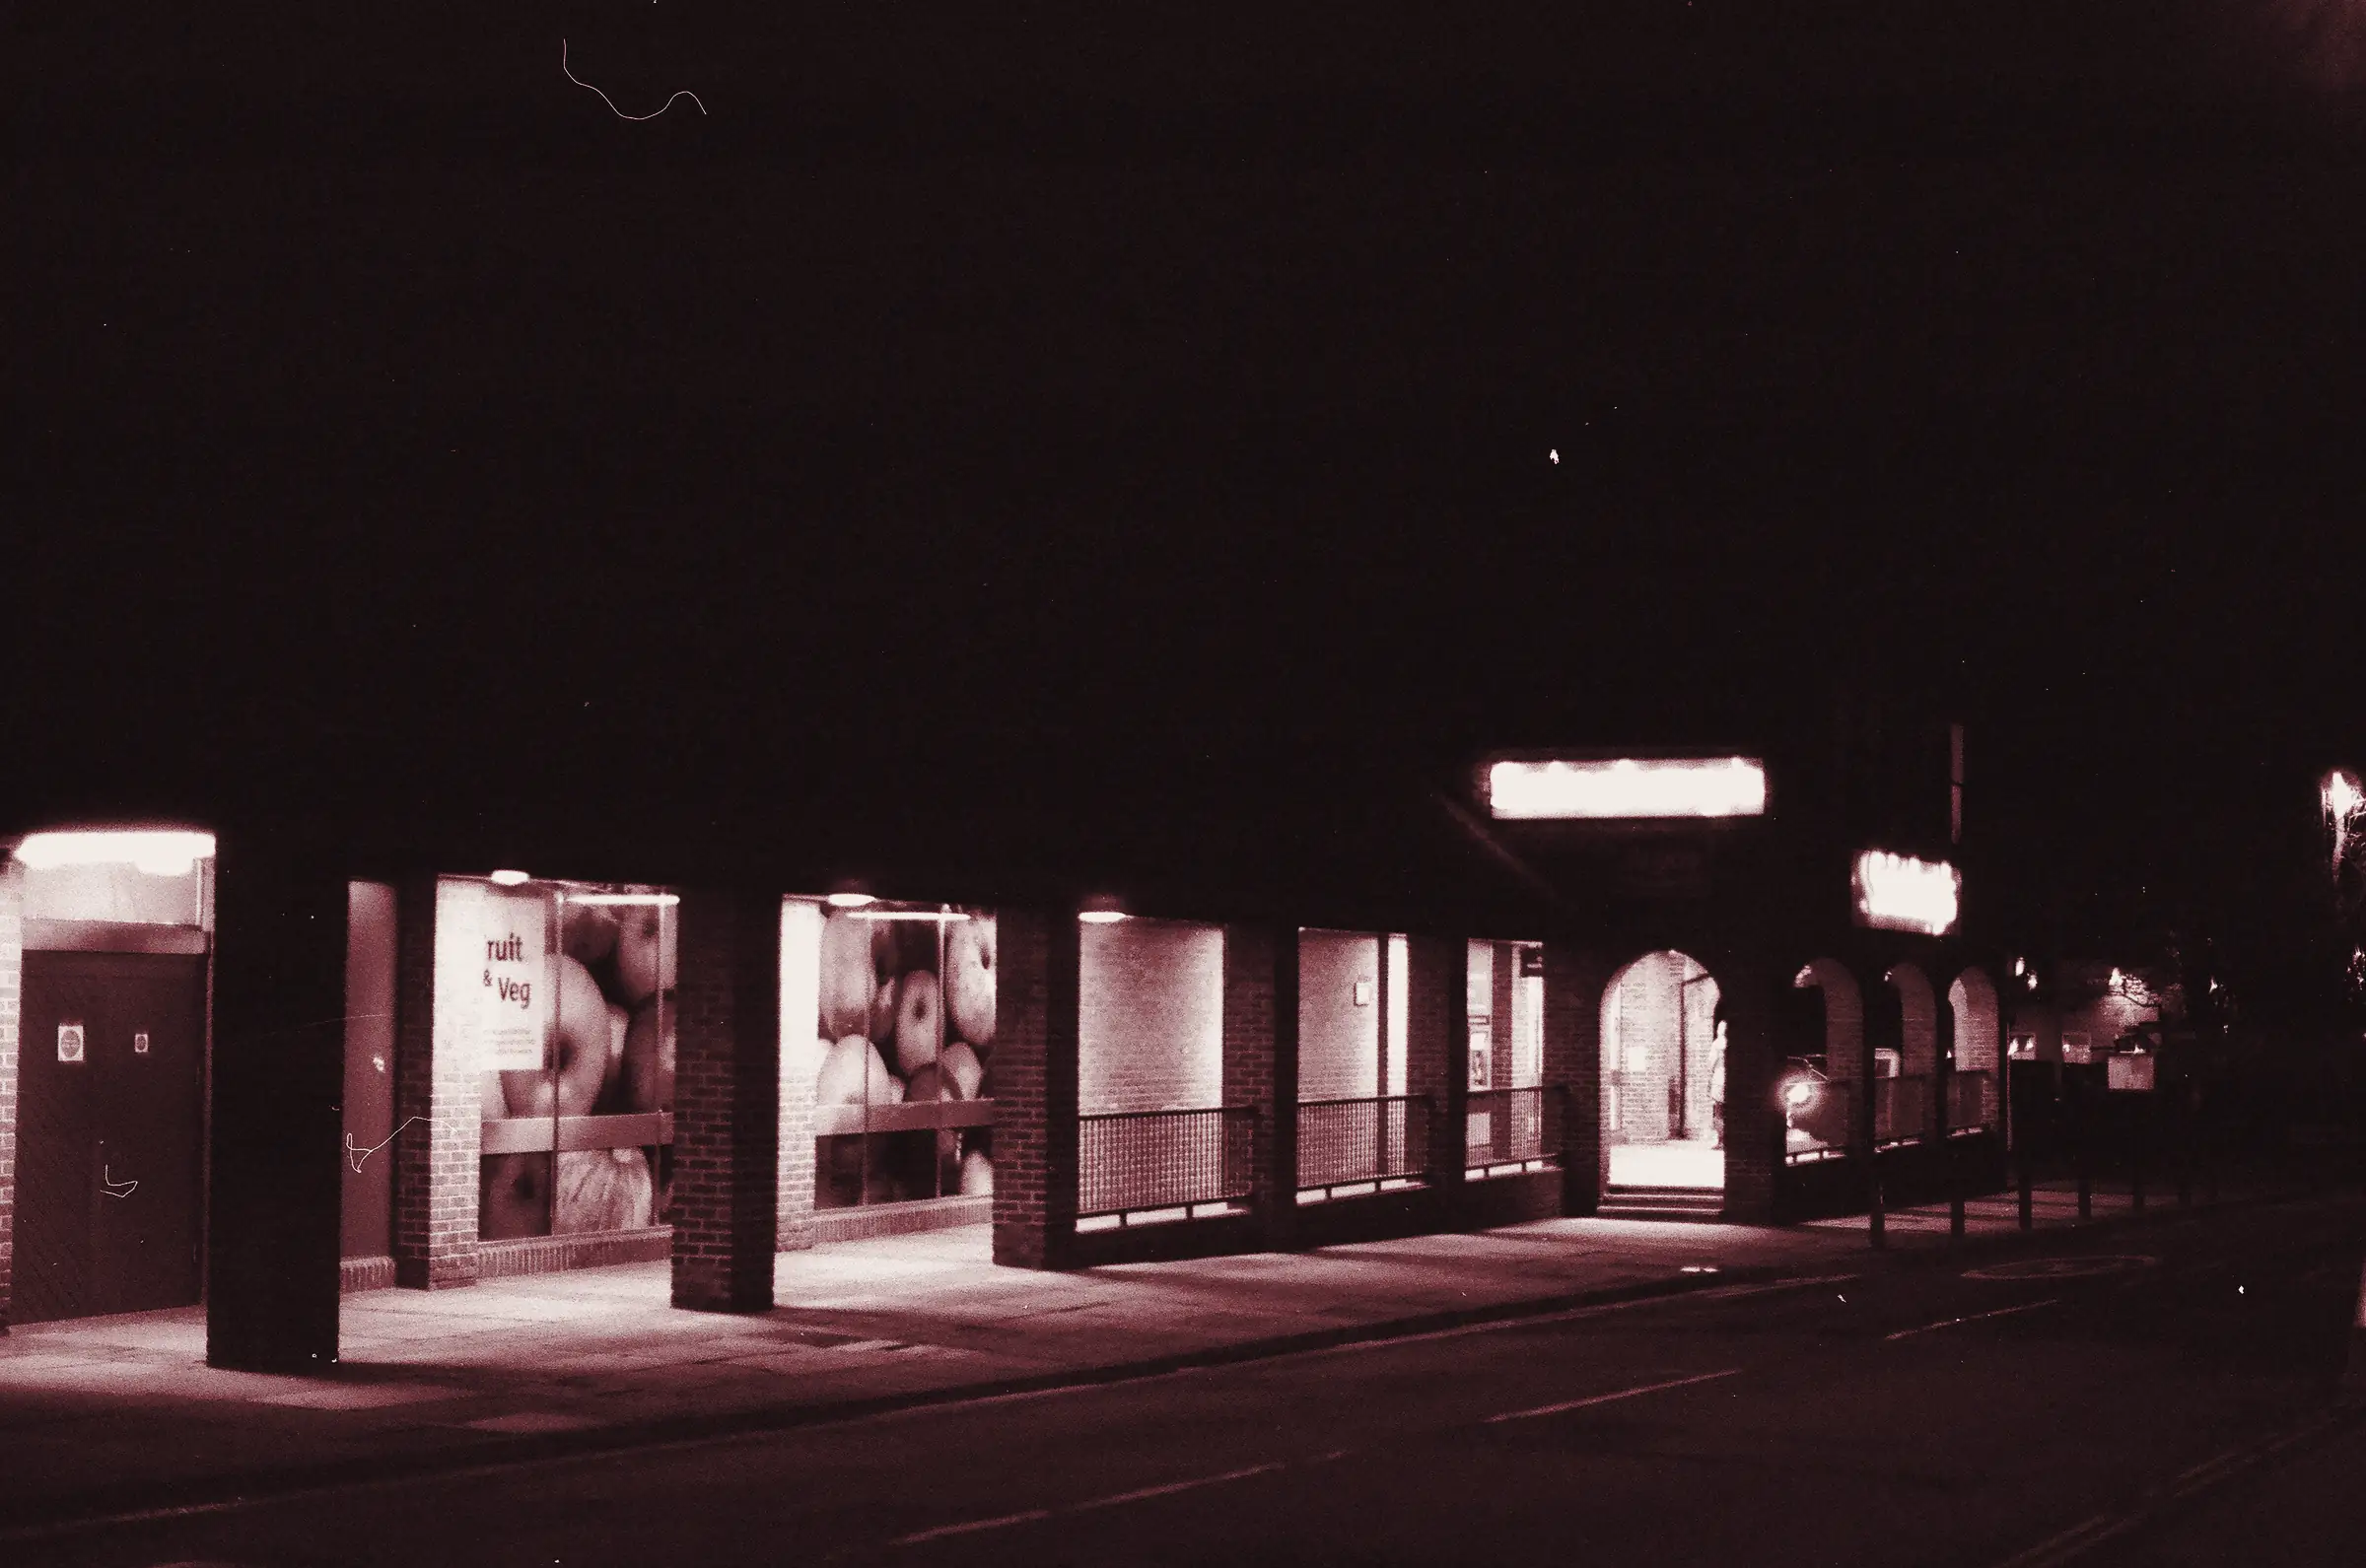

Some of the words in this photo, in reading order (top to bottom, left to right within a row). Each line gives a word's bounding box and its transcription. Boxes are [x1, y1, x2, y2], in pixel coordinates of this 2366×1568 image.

[487, 932, 522, 962] ruit
[483, 969, 493, 988] &
[498, 977, 530, 1009] Veg
